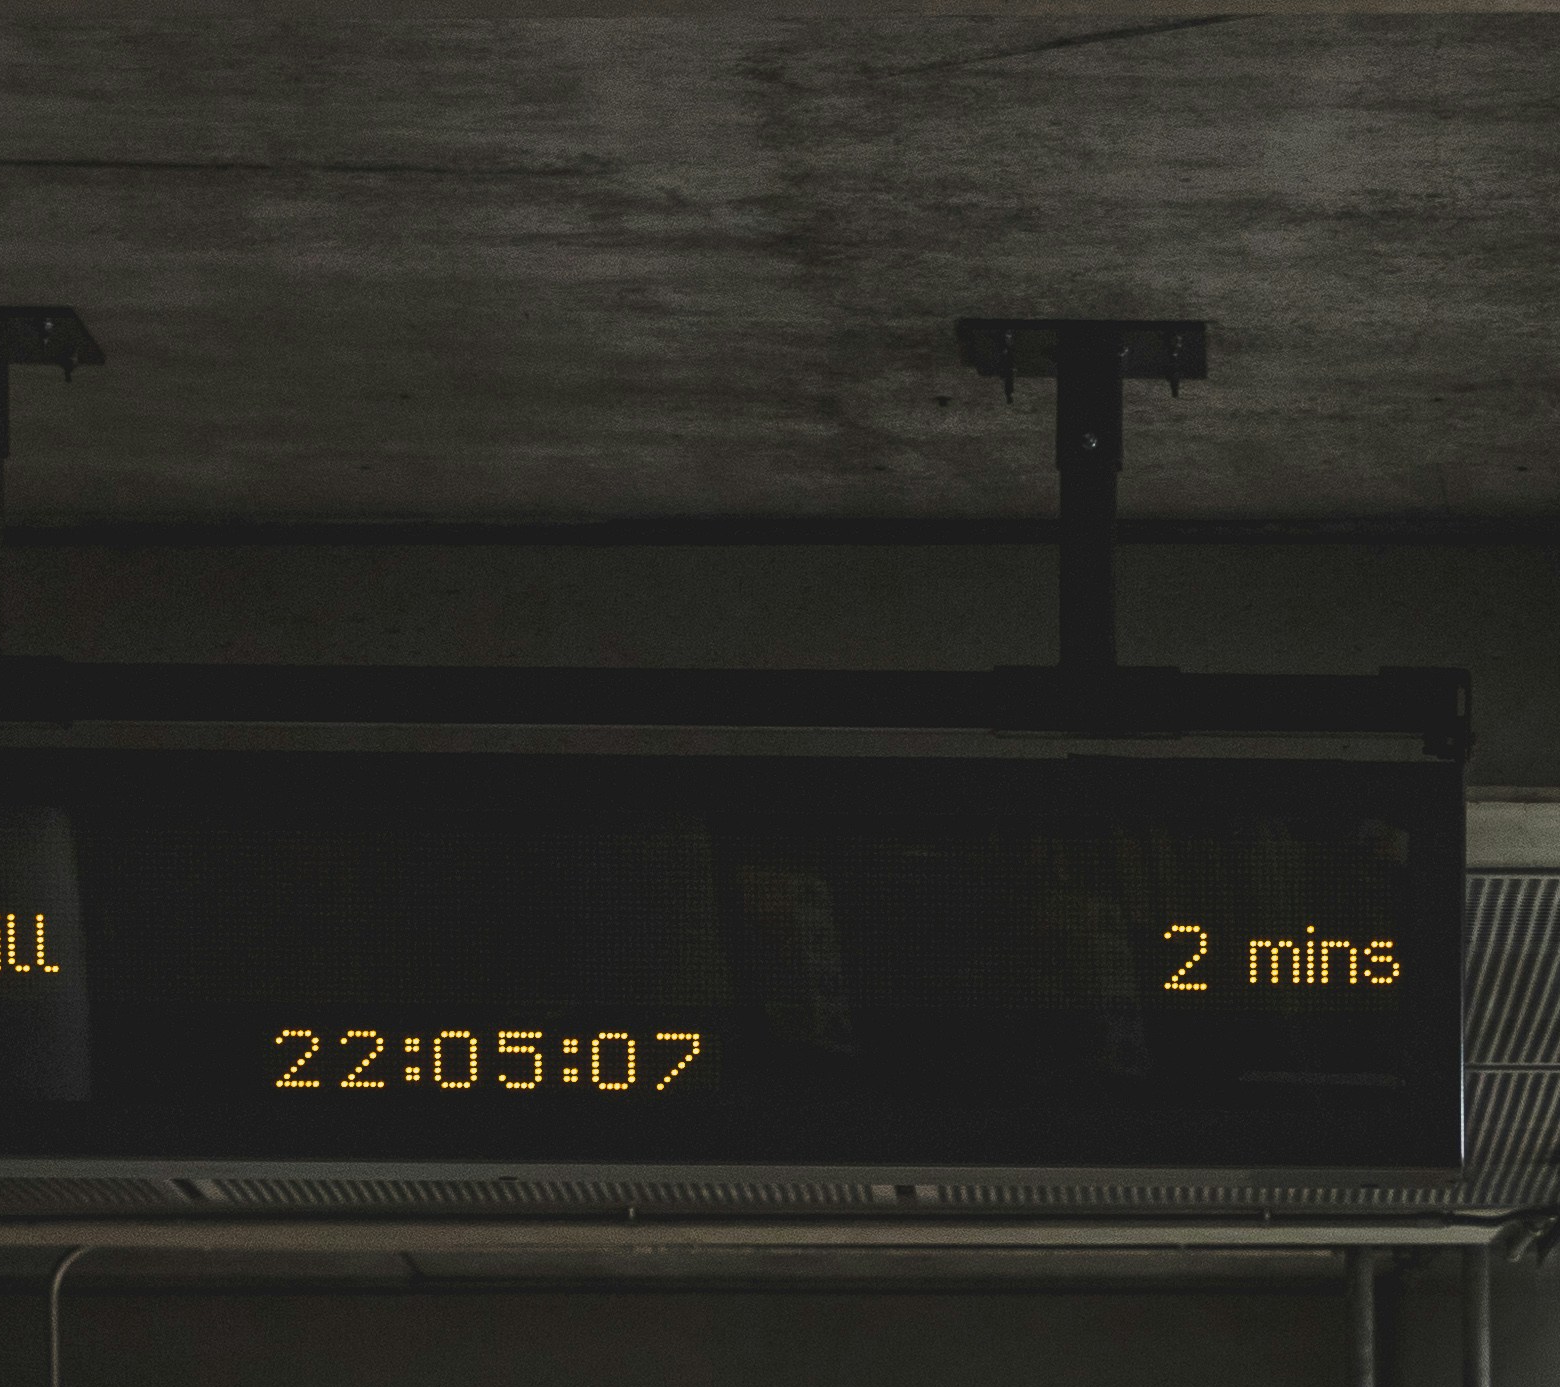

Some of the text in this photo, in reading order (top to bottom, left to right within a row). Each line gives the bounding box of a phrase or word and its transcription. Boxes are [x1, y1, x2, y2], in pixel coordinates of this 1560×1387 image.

[1162, 923, 1209, 992] 2
[1248, 924, 1401, 990] mins
[274, 1028, 702, 1092] 22:05:07
